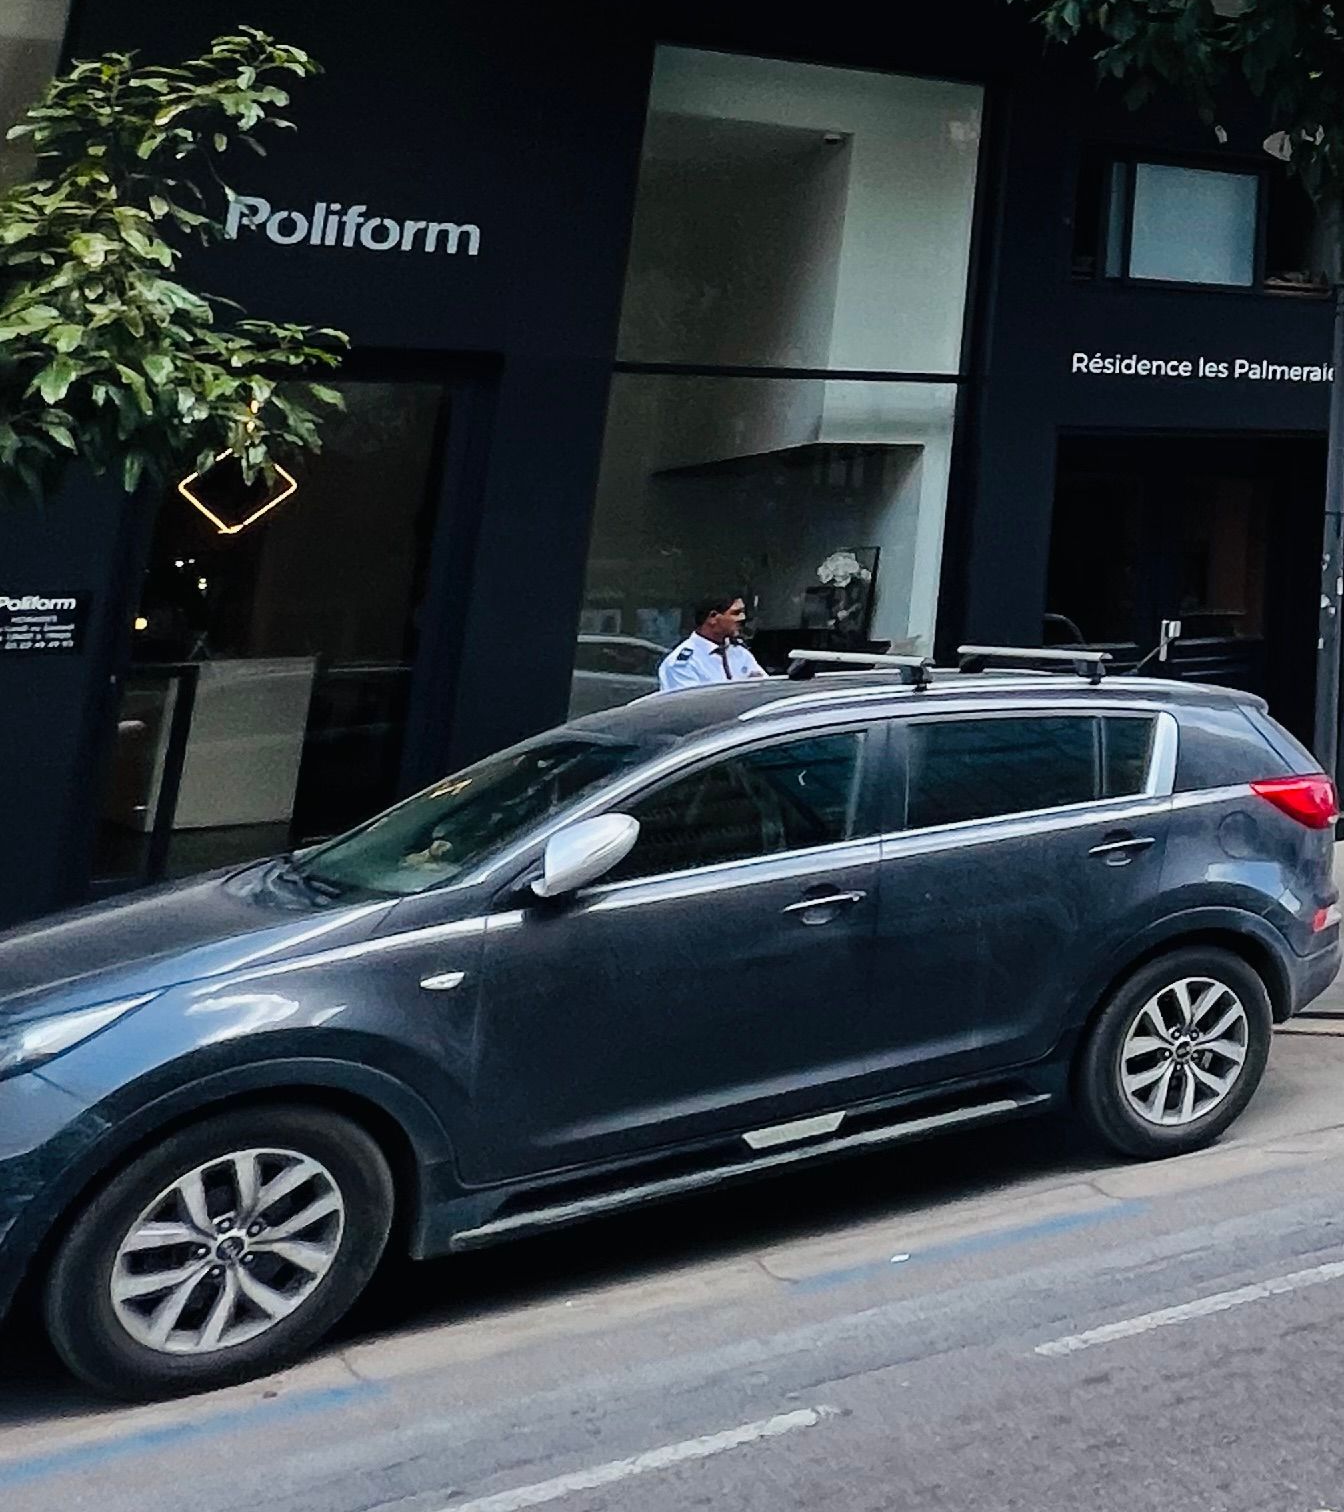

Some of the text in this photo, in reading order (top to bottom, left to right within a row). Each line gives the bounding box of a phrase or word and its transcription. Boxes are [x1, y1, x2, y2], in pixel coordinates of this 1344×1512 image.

[223, 195, 480, 256] Poliform
[1072, 352, 1193, 377] Résidence
[1198, 357, 1230, 379] les
